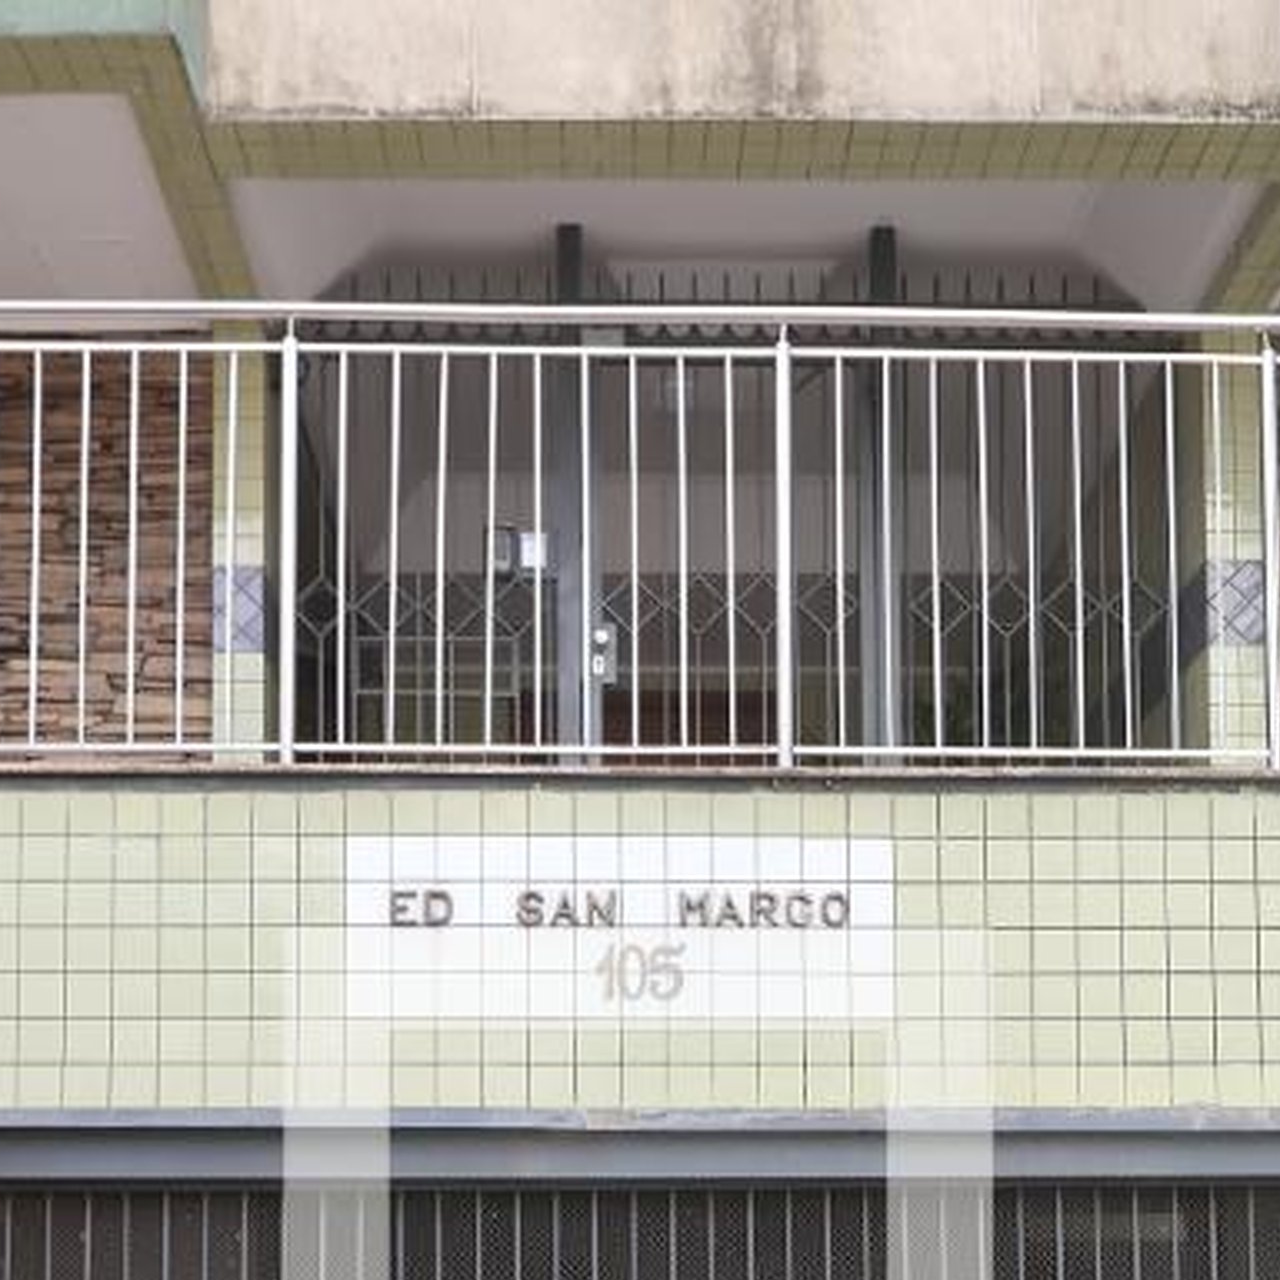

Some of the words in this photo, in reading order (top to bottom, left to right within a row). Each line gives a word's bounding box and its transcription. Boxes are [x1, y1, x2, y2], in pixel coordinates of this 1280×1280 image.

[389, 889, 454, 928] ED
[515, 889, 618, 928] SAN
[594, 941, 688, 1001] 105
